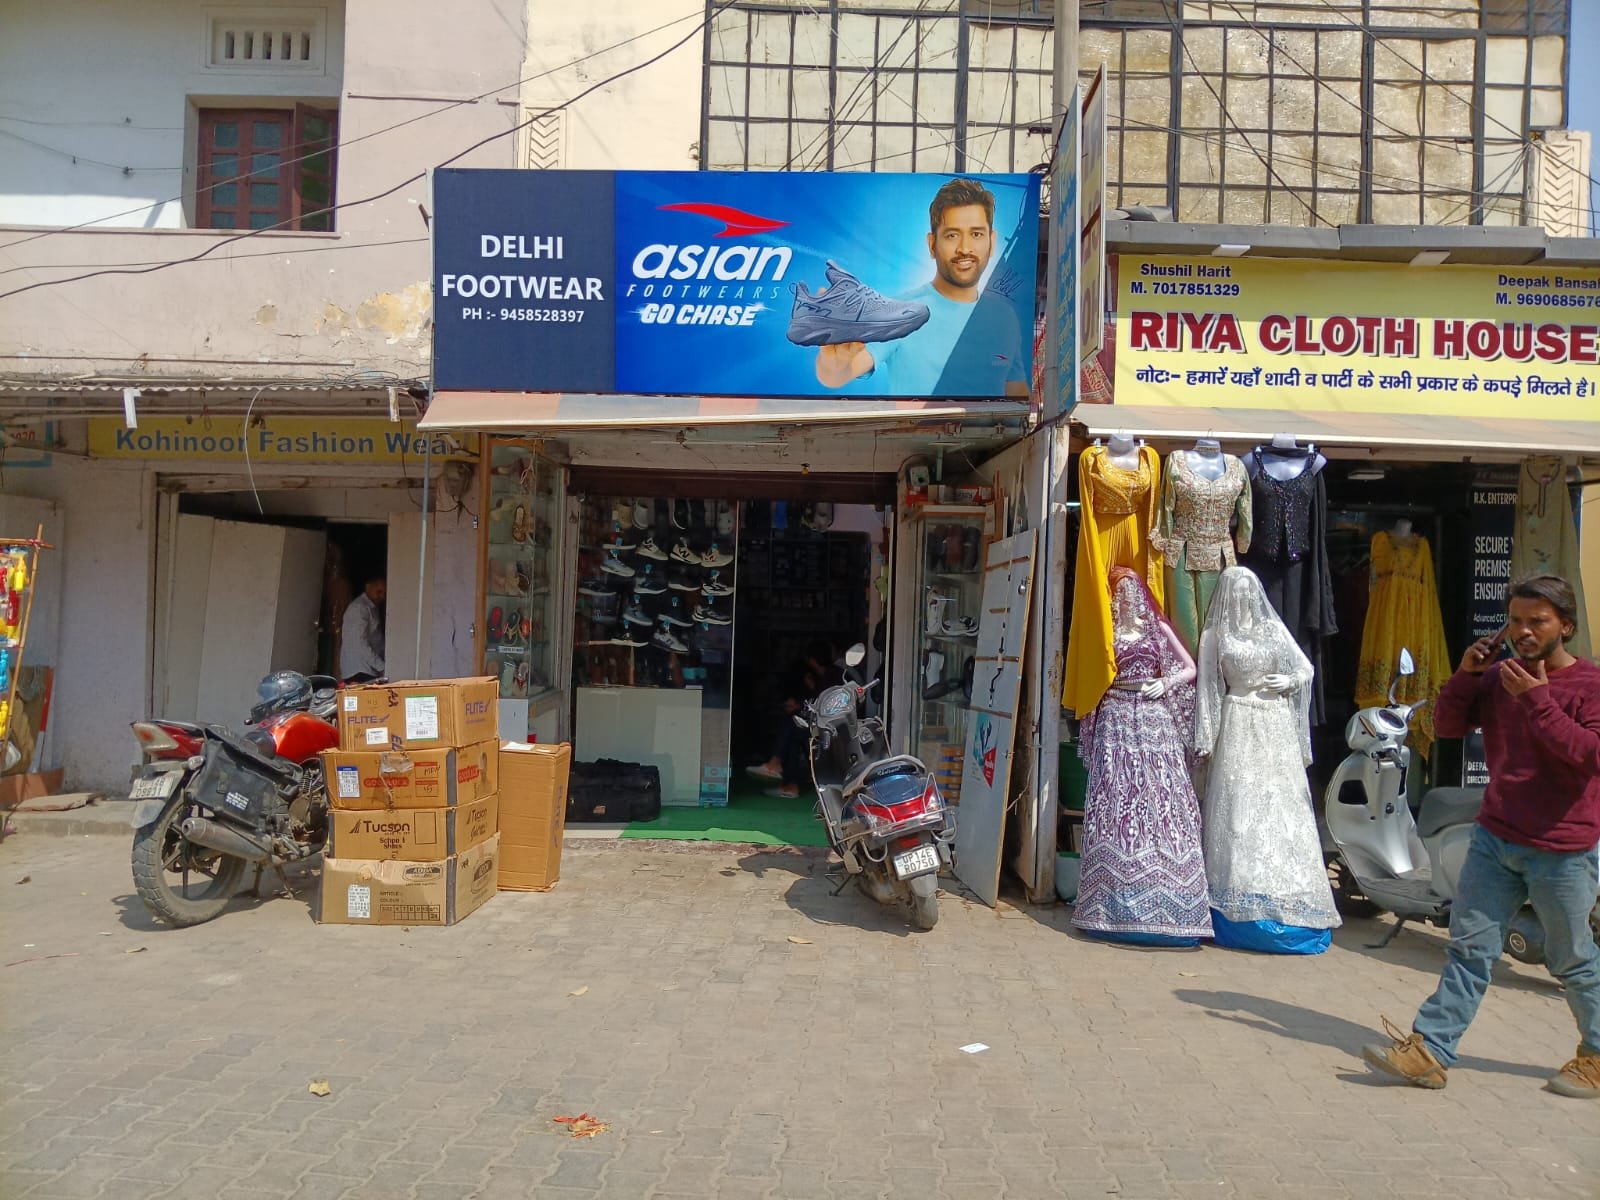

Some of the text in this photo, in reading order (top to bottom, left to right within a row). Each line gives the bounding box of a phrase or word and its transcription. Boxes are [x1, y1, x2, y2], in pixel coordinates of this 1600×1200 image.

[481, 234, 564, 259] DELHI
[632, 243, 793, 281] asian
[1140, 263, 1232, 278] Shushil Harit
[442, 274, 605, 301] FOOTWEAR
[1131, 282, 1240, 297] M. 7017851329
[1498, 275, 1550, 289] Deepak
[626, 284, 780, 299] FOOTWEARS
[1496, 292, 1512, 305] M.
[462, 307, 485, 321] PH
[500, 308, 585, 323] 9458528397
[640, 303, 761, 327] GO CHASE
[1130, 311, 1600, 364] RIYA CLOTH HOUSE
[1231, 366, 1263, 387] यहाँ
[1265, 367, 1301, 387] शादी
[1304, 373, 1318, 387] व
[1321, 368, 1354, 388] पार्टी
[1357, 370, 1375, 389] के
[1379, 370, 1413, 390] सभी
[1416, 376, 1459, 393] प्रकार
[1462, 374, 1479, 391] के
[1483, 376, 1523, 398] कपड़े
[1527, 375, 1573, 396] मिलते
[116, 429, 247, 453] Kohinoor
[259, 431, 374, 454] Fashion
[1474, 536, 1509, 554] SECURE
[465, 702, 484, 716] FLITE
[348, 715, 378, 725] FLITE
[1467, 761, 1488, 771] DEEPA
[363, 820, 411, 833] Tucson
